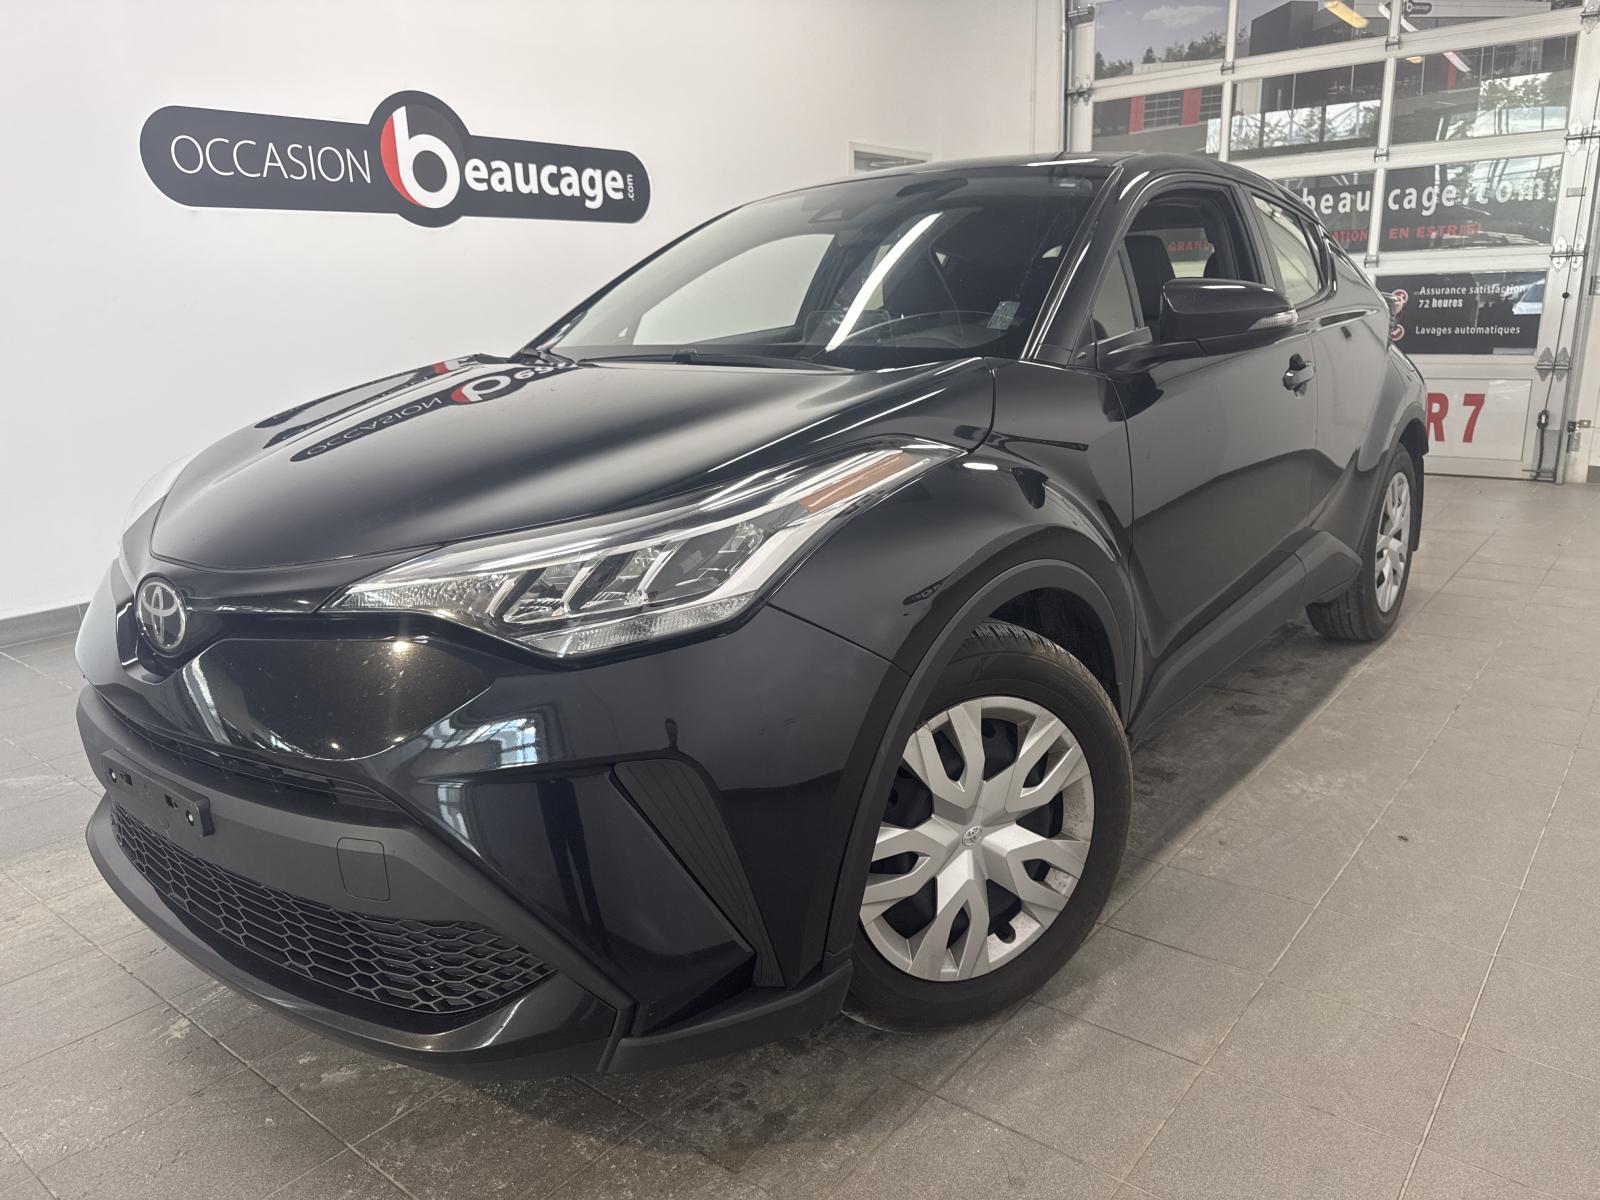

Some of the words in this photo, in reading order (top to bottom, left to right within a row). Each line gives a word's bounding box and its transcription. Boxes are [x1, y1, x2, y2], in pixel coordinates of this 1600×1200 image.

[170, 134, 372, 184] OCCASION
[387, 105, 625, 209] beaucage
[626, 173, 635, 202] .com
[1388, 226, 1411, 241] EN
[1419, 285, 1467, 296] Assurance
[1469, 283, 1526, 296] satisfaction
[1418, 299, 1430, 309] 72
[1431, 297, 1464, 309] heures
[1415, 325, 1452, 337] Lavages
[1454, 324, 1521, 337] automatiques
[1462, 393, 1486, 443] 7
